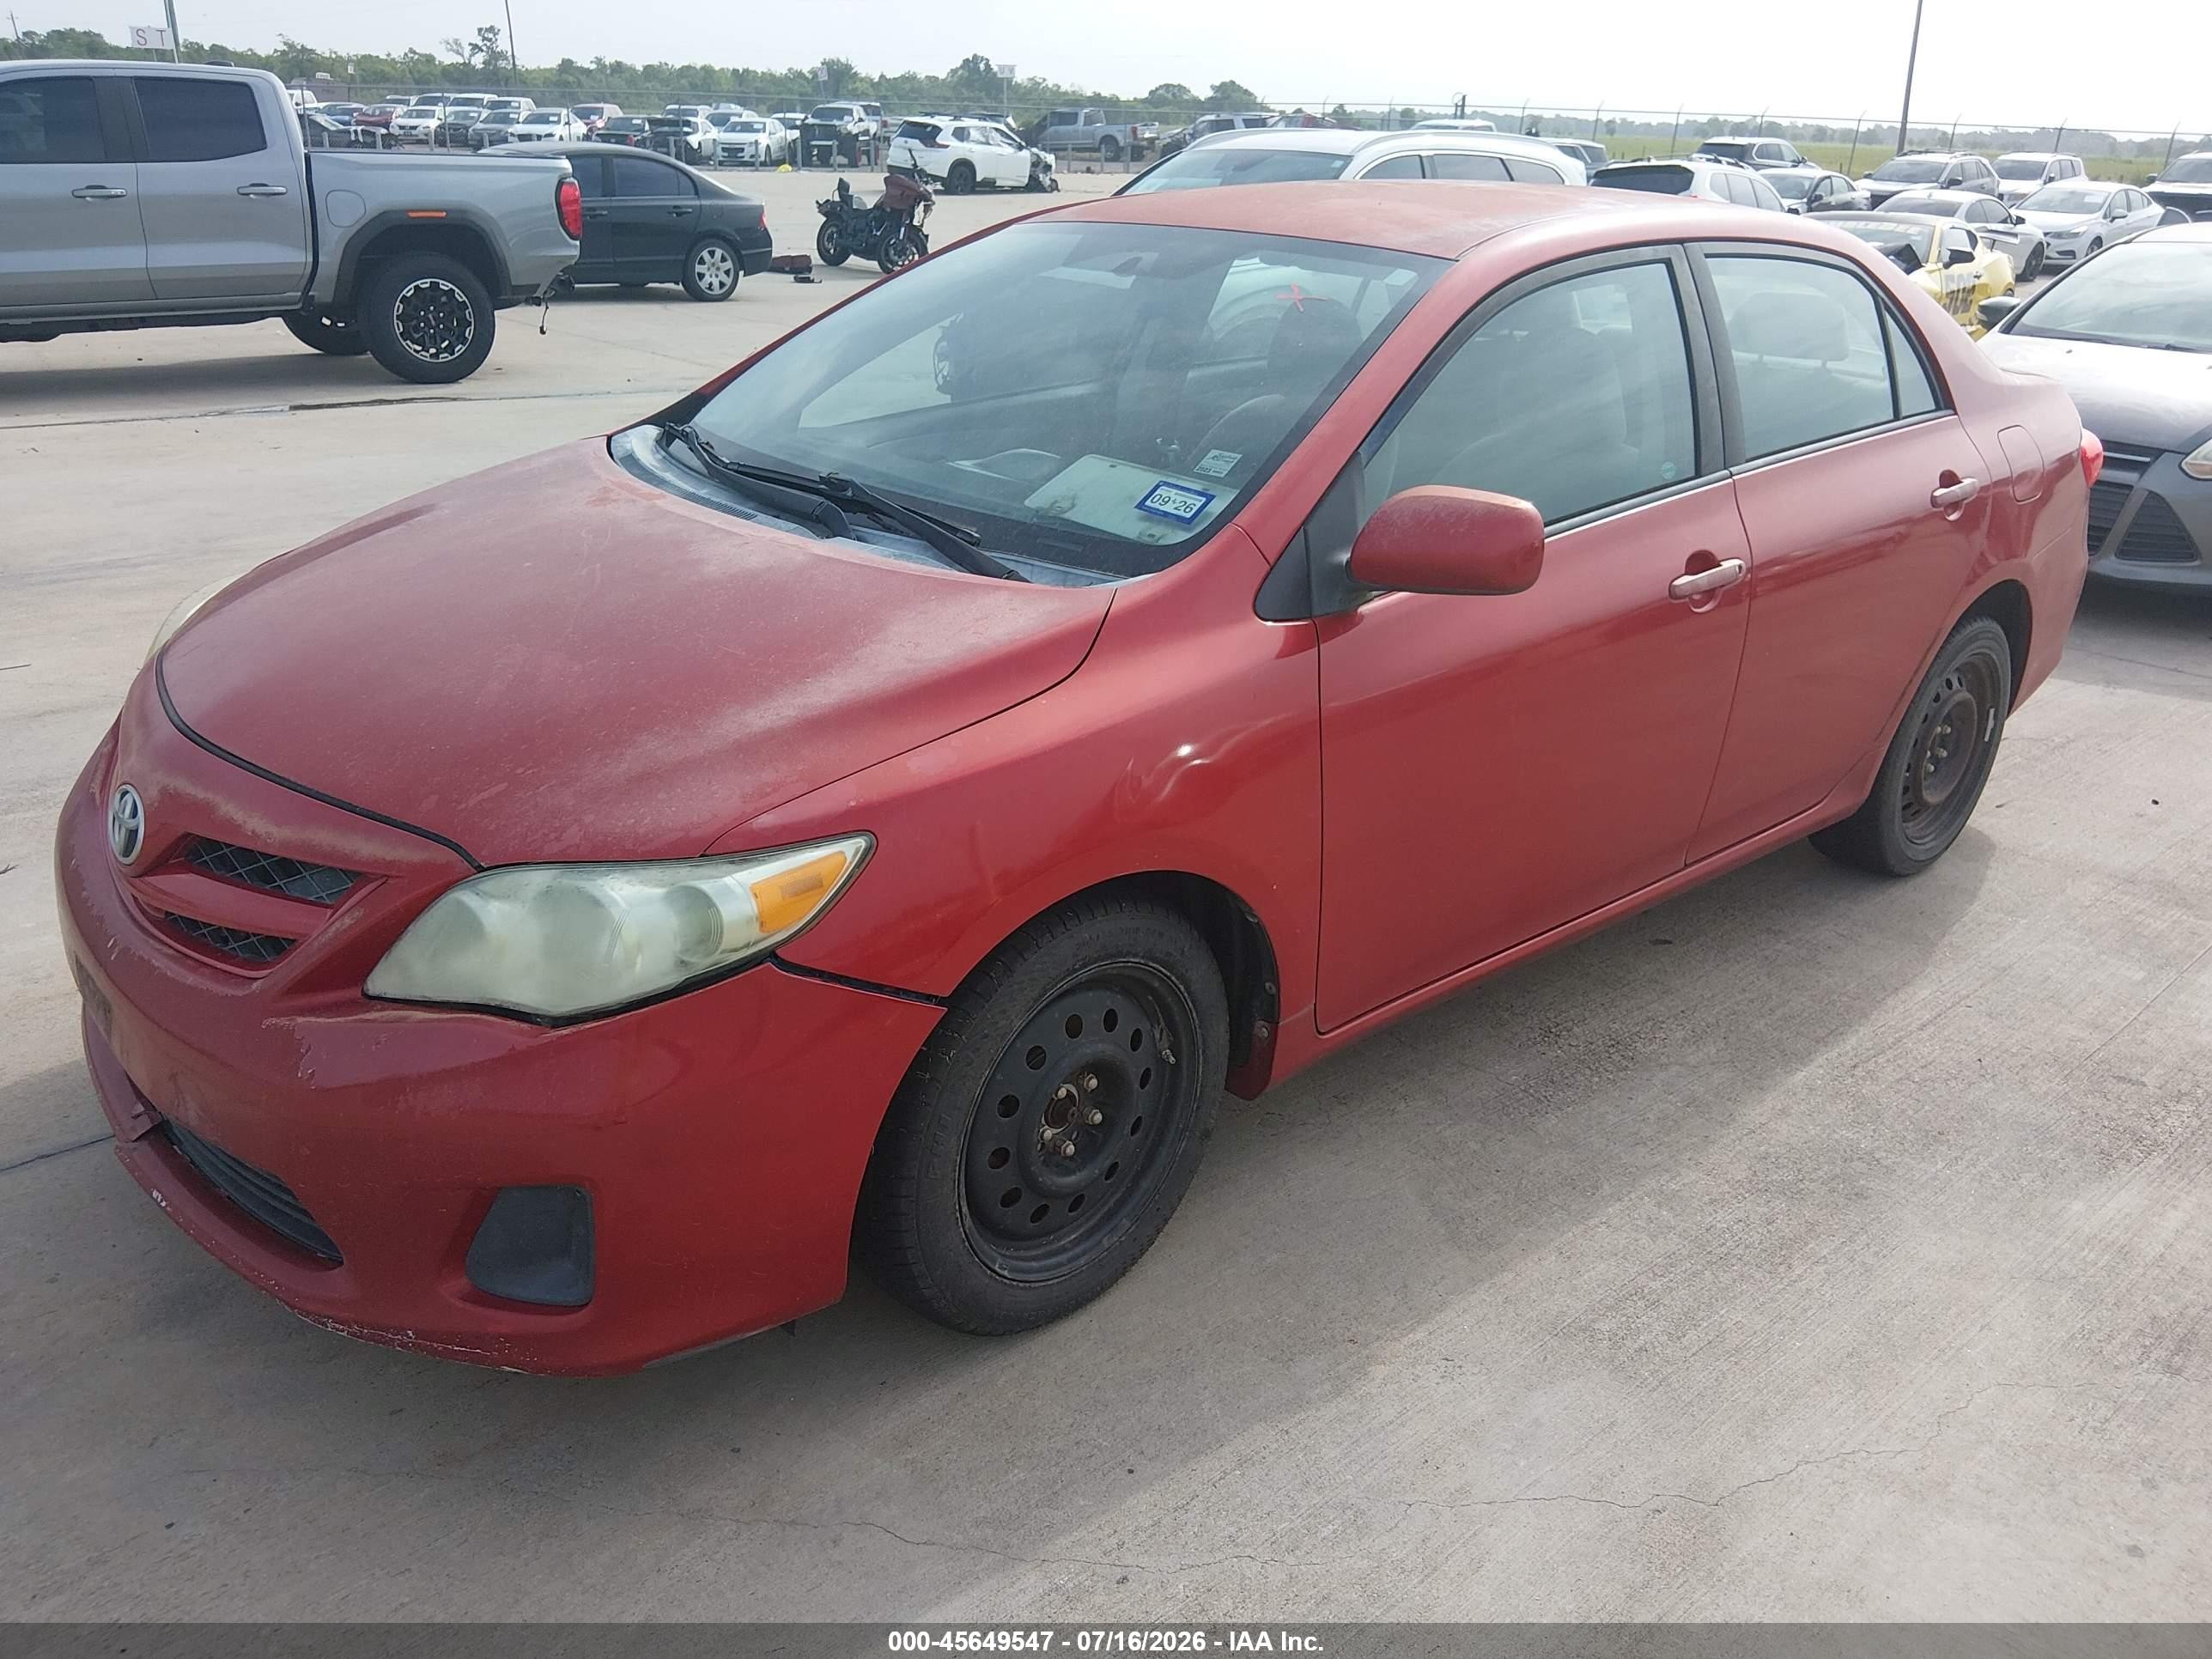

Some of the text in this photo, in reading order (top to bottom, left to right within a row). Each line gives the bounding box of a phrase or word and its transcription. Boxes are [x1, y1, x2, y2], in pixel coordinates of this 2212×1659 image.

[136, 28, 167, 47] S T
[1151, 493, 1171, 507] 09
[1173, 500, 1196, 514] 26
